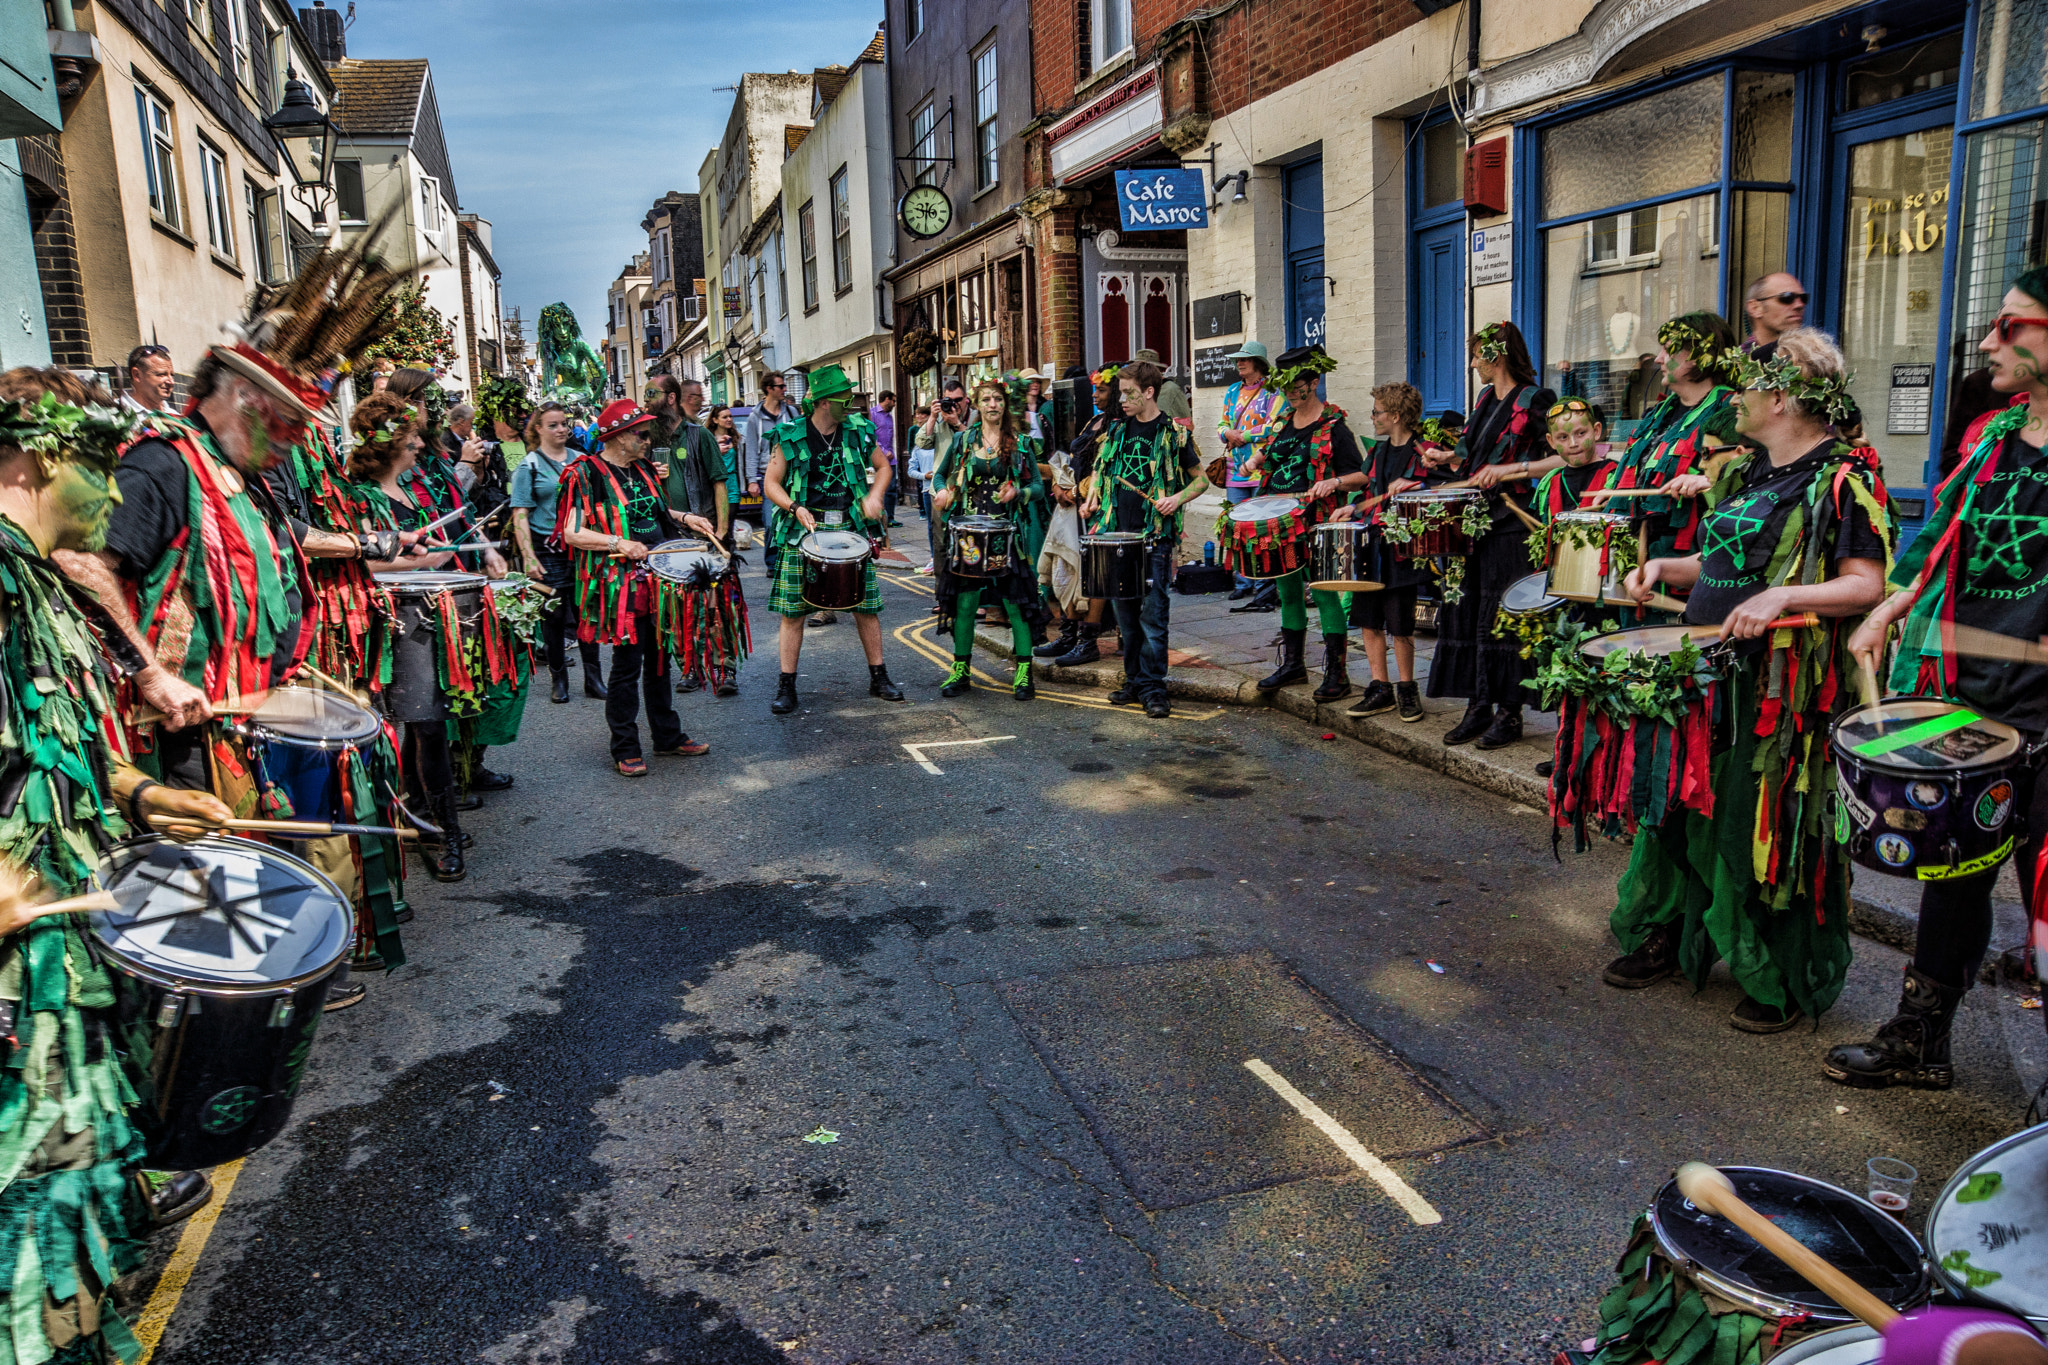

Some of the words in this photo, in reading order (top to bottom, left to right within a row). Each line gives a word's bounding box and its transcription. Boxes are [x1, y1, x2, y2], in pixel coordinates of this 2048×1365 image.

[1125, 176, 1175, 201] Cafe
[1128, 203, 1201, 225] Maroc
[1477, 274, 1493, 283] Display
[1906, 290, 1928, 311] 38
[1894, 367, 1930, 376] OPENING
[1896, 376, 1926, 385] HOURS
